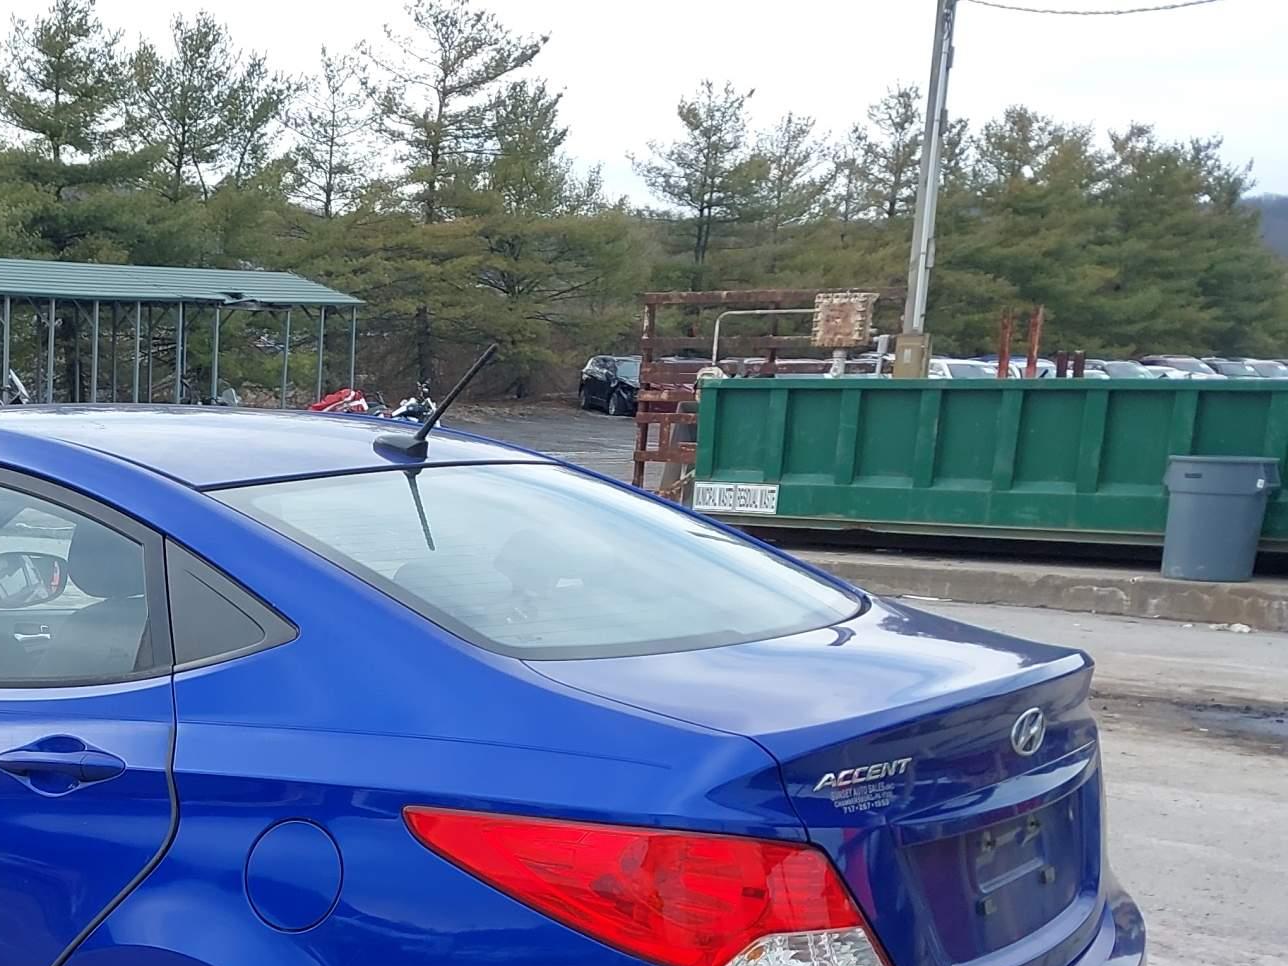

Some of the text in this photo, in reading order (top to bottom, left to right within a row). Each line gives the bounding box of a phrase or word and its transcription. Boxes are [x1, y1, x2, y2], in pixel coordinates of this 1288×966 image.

[759, 489, 777, 509] WASTE
[813, 757, 912, 792] ACCENT
[868, 782, 885, 794] SALES
